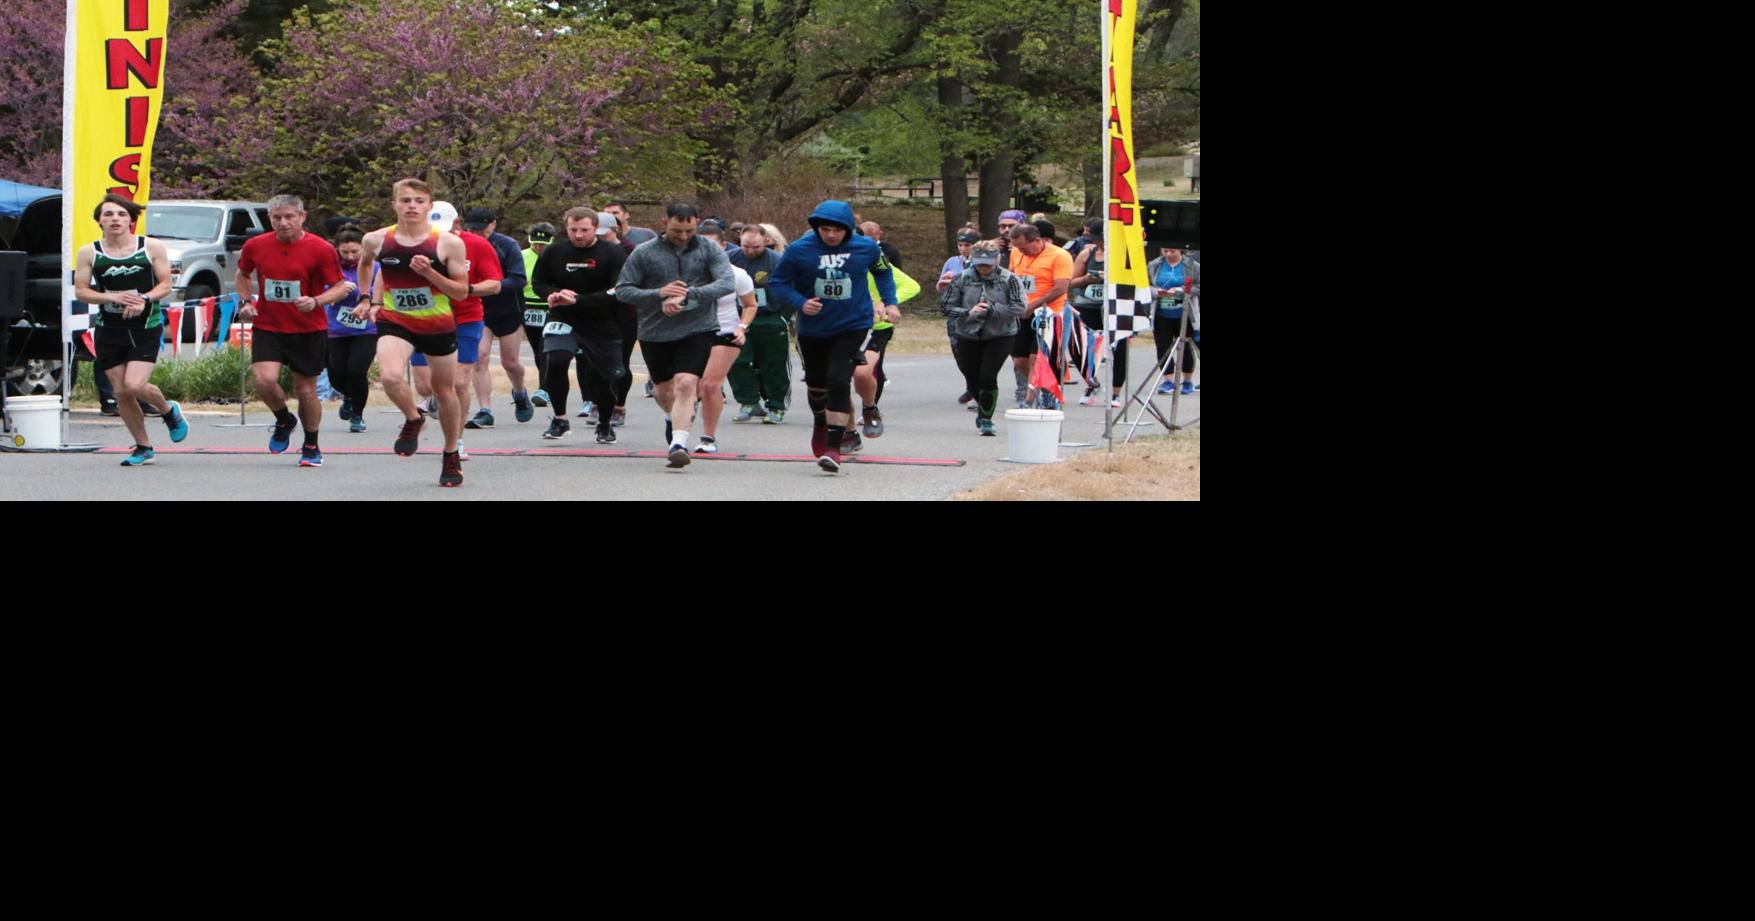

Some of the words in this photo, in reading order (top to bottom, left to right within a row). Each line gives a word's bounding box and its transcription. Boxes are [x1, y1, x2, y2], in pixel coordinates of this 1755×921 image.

[105, 0, 164, 237] INIS
[275, 286, 290, 298] 91
[824, 285, 843, 296] 80
[396, 294, 428, 307] 286
[524, 314, 543, 323] 288
